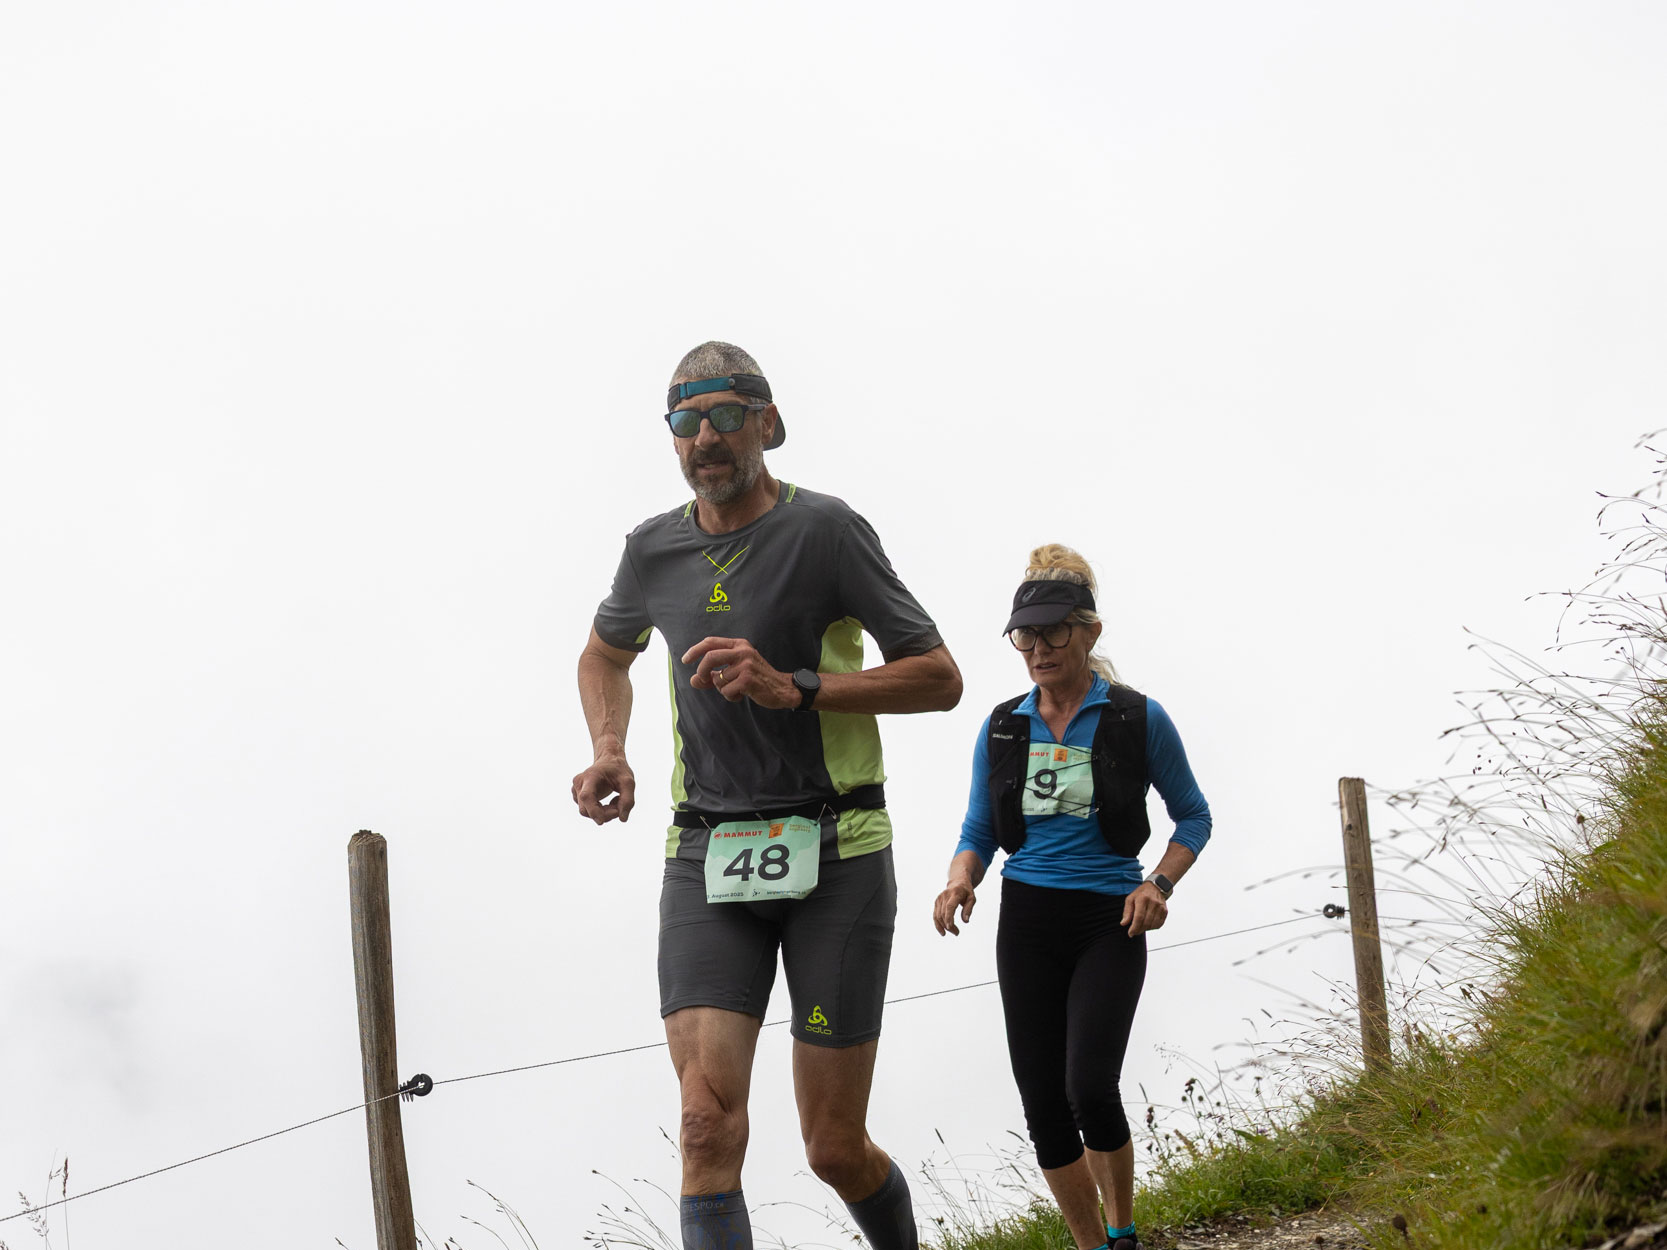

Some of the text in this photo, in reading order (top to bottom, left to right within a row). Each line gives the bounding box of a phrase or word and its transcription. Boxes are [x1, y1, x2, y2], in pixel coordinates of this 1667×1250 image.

[705, 604, 731, 612] odlo
[1033, 768, 1057, 799] 9
[723, 830, 763, 839] MAMMUT
[723, 843, 790, 882] 48
[805, 1025, 832, 1035] odlo
